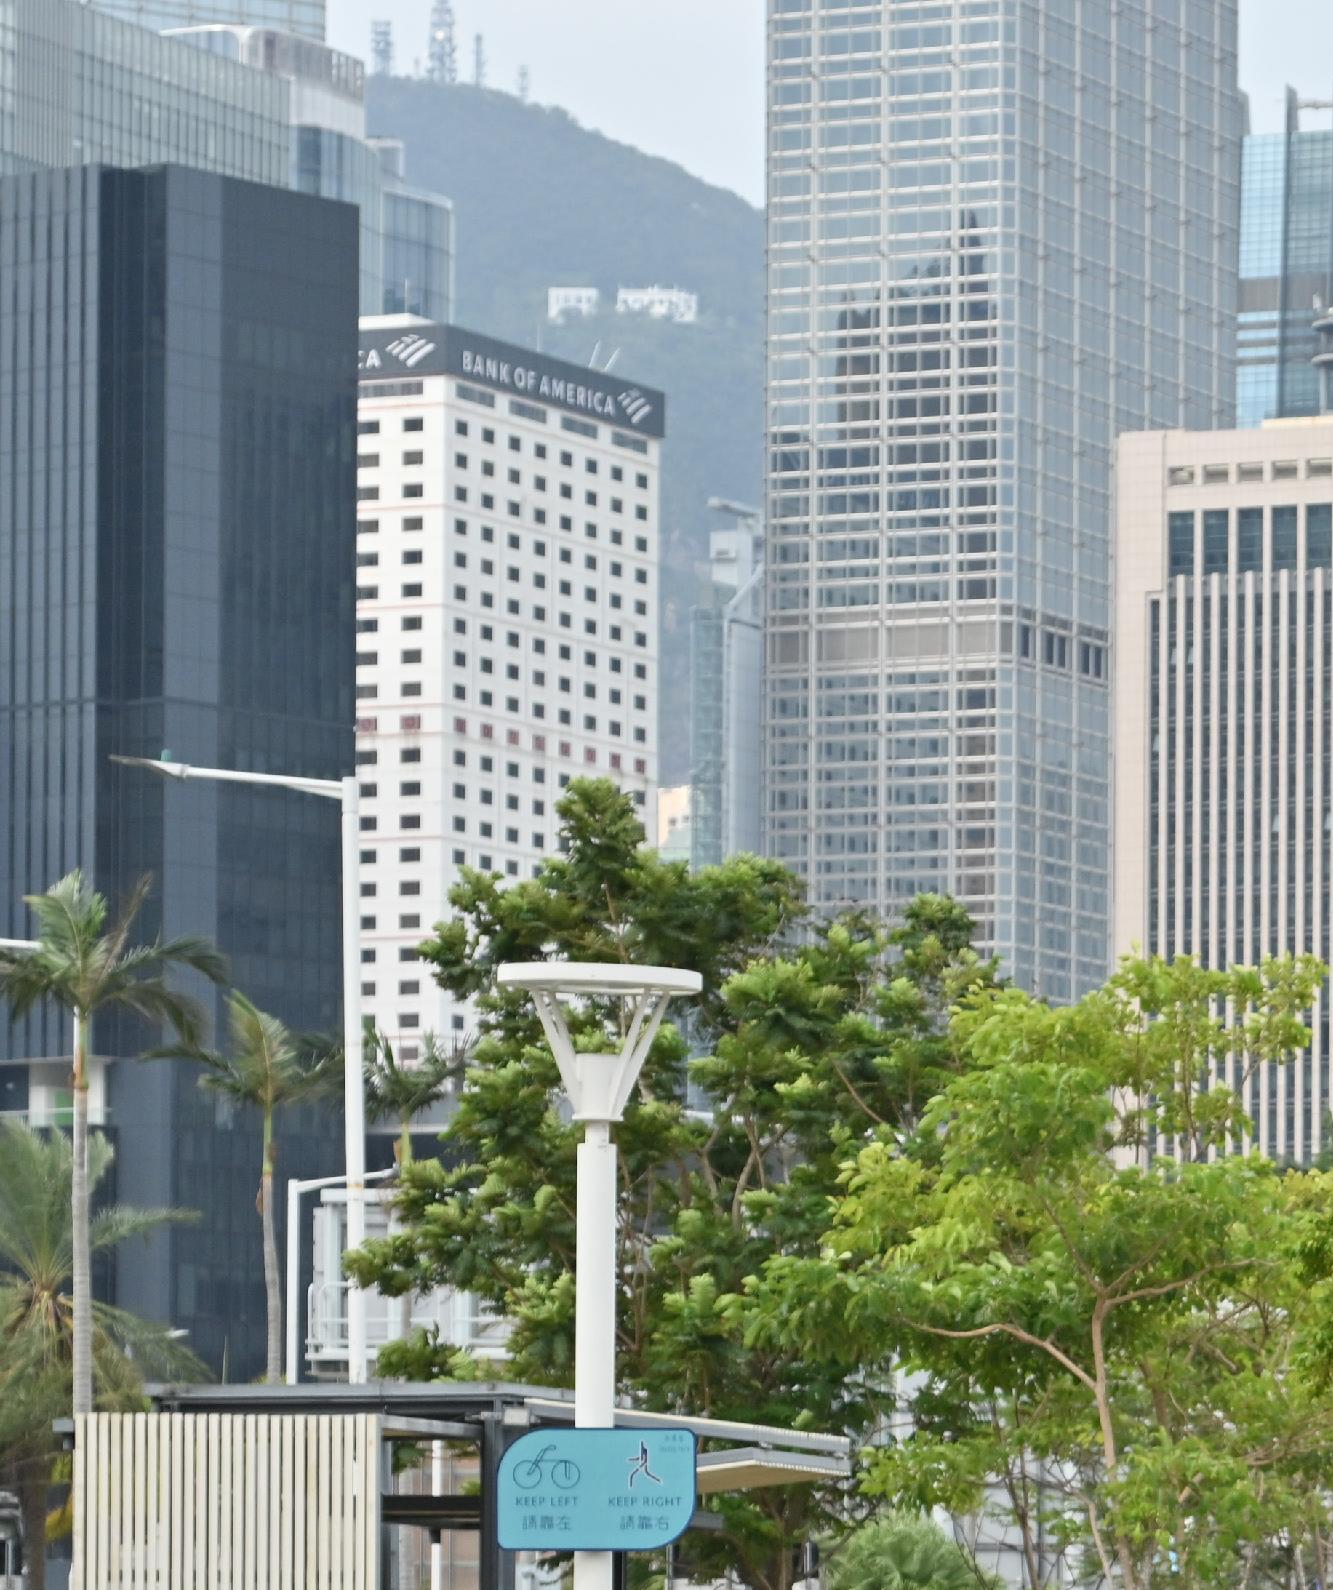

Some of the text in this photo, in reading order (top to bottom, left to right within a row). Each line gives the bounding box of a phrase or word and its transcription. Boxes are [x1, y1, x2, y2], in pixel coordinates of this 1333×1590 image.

[462, 351, 616, 417] BANK OF AMERICA
[514, 1495, 579, 1508] KEEP LEFT
[607, 1495, 682, 1508] KEEP RIGHT
